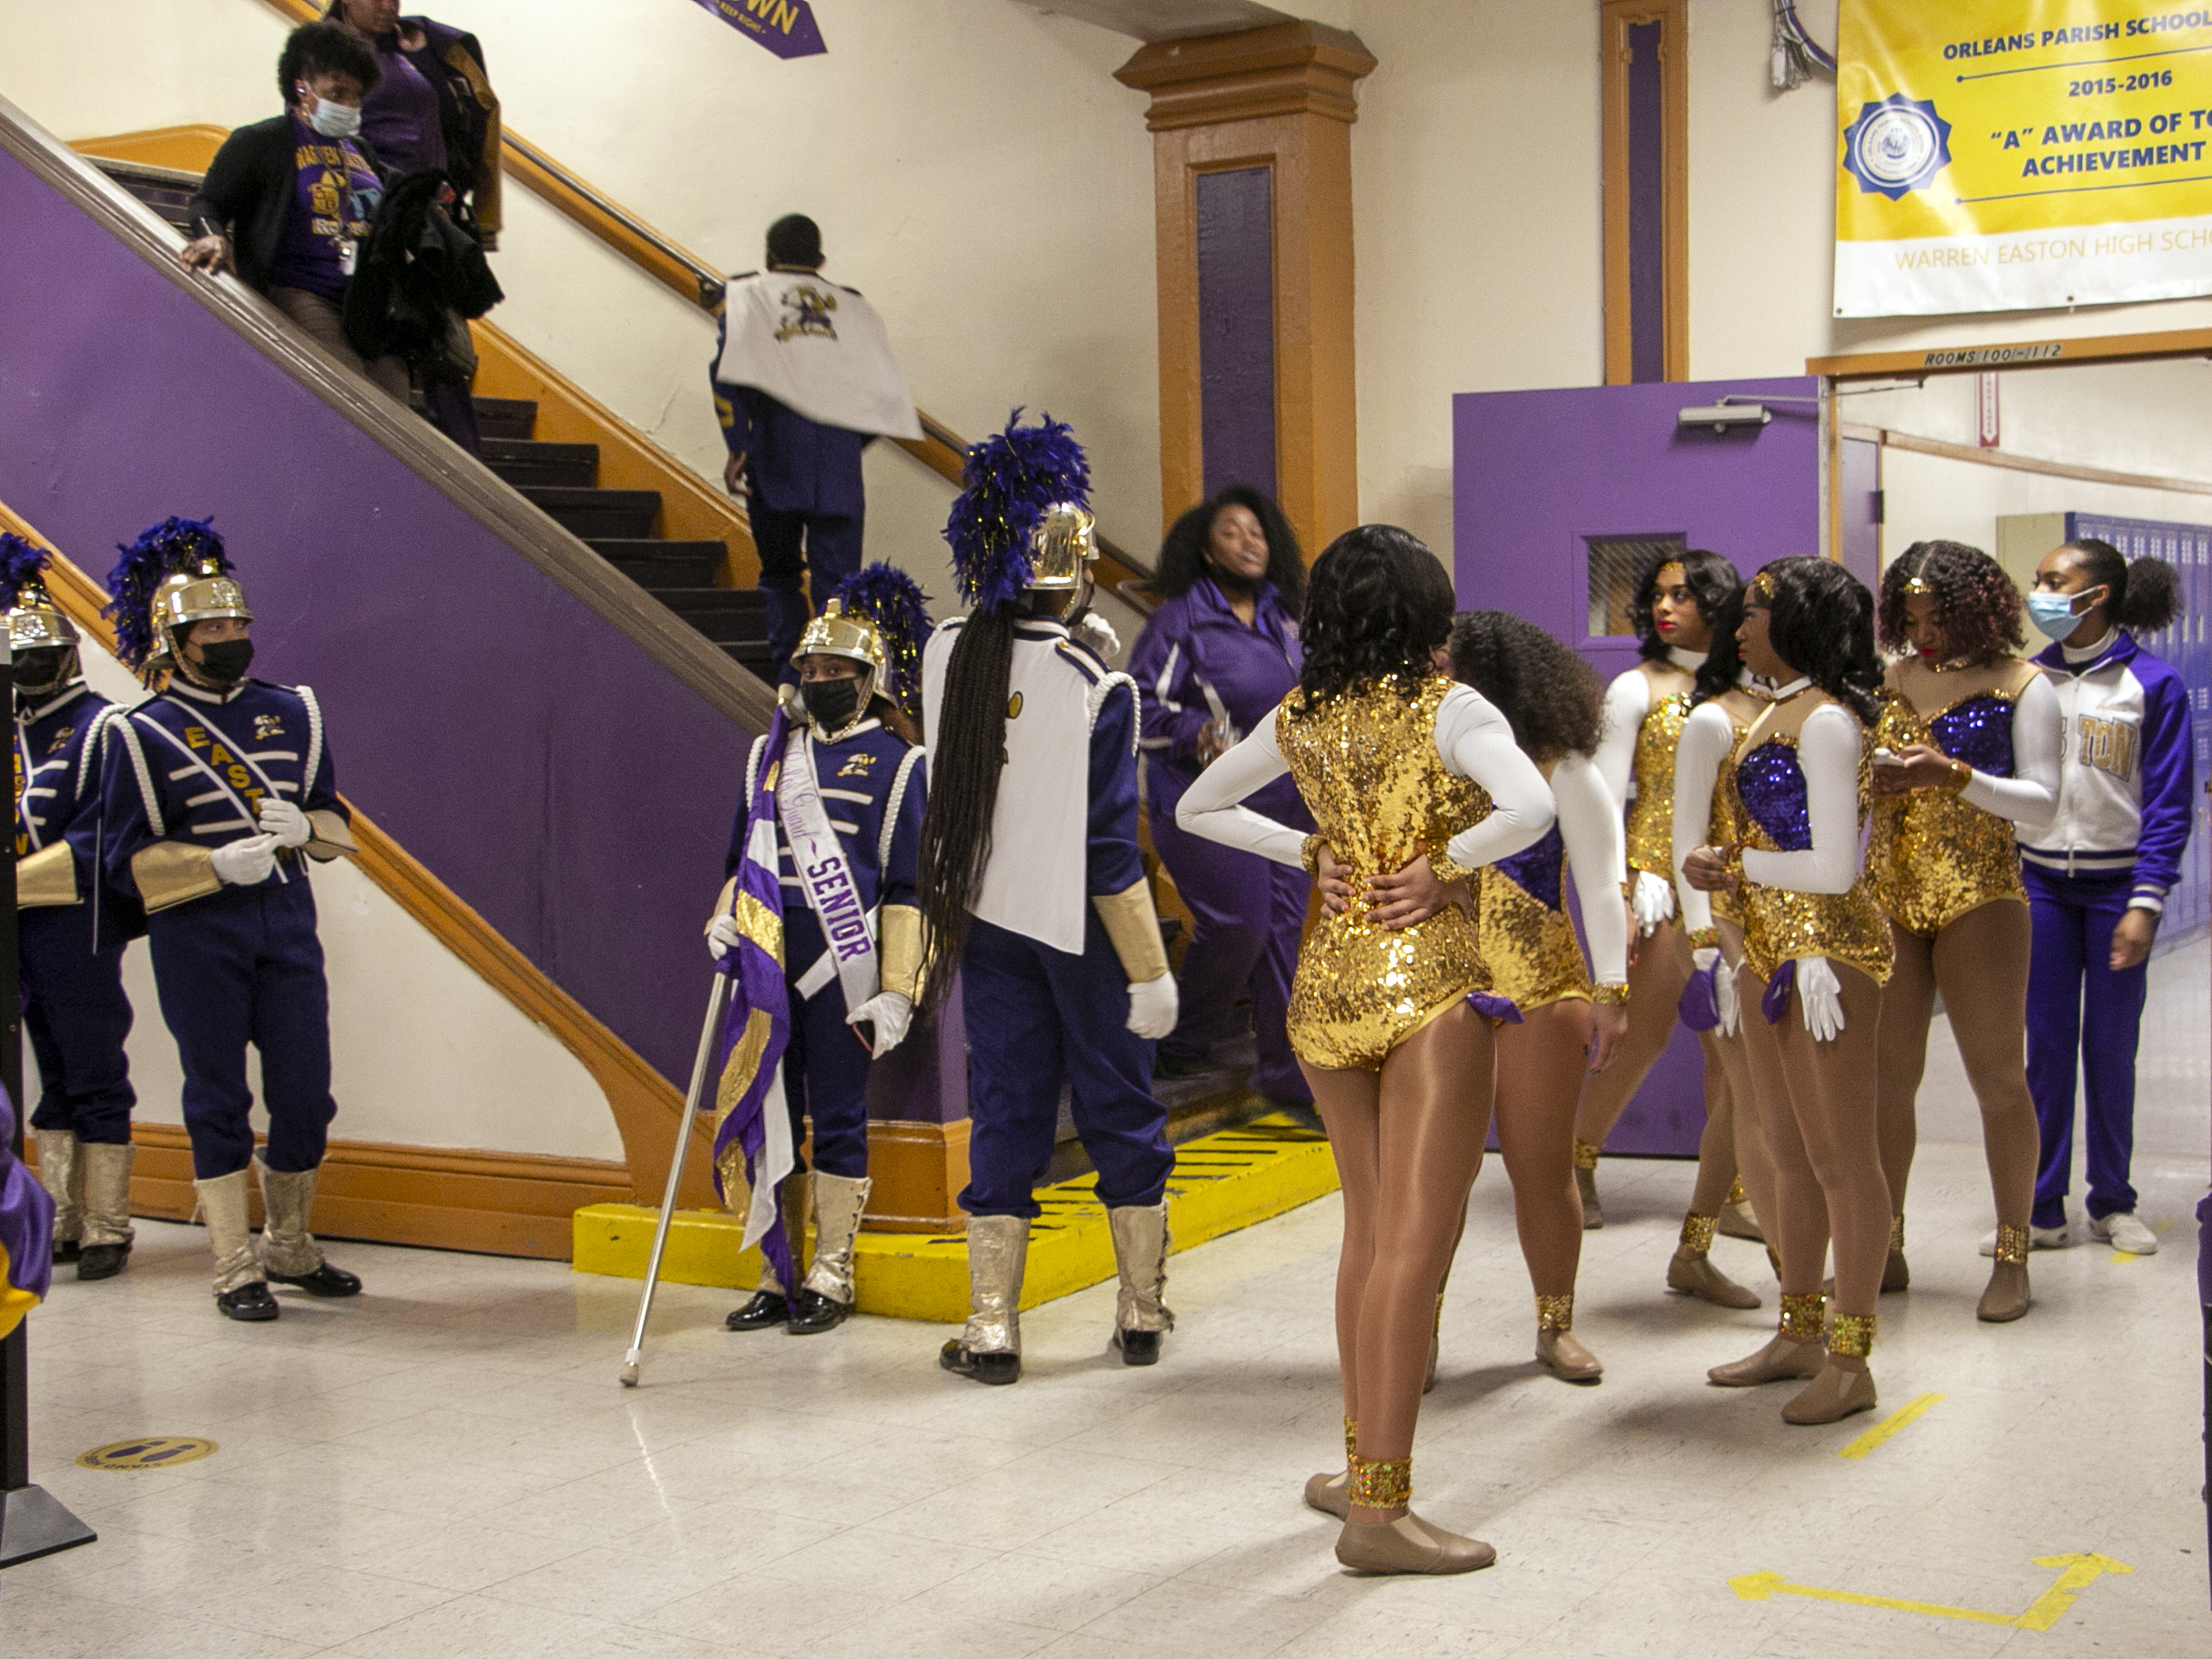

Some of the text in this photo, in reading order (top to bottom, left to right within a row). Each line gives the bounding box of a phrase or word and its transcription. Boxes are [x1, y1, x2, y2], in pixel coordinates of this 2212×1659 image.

[743, 0, 800, 35] WN
[1942, 32, 2035, 60] ORLEANS
[2041, 22, 2119, 47] PARISH
[2068, 69, 2173, 97] 2015-2016
[2041, 117, 2142, 146] AWARD
[2149, 112, 2182, 135] OF
[2022, 140, 2207, 178] ACHIEVEMENT
[1894, 246, 1990, 270] WARREN
[1997, 238, 2085, 265] EASTON
[2095, 232, 2153, 256] HIGH
[1924, 351, 1976, 365] ROOMS
[807, 856, 872, 962] SENIOR
